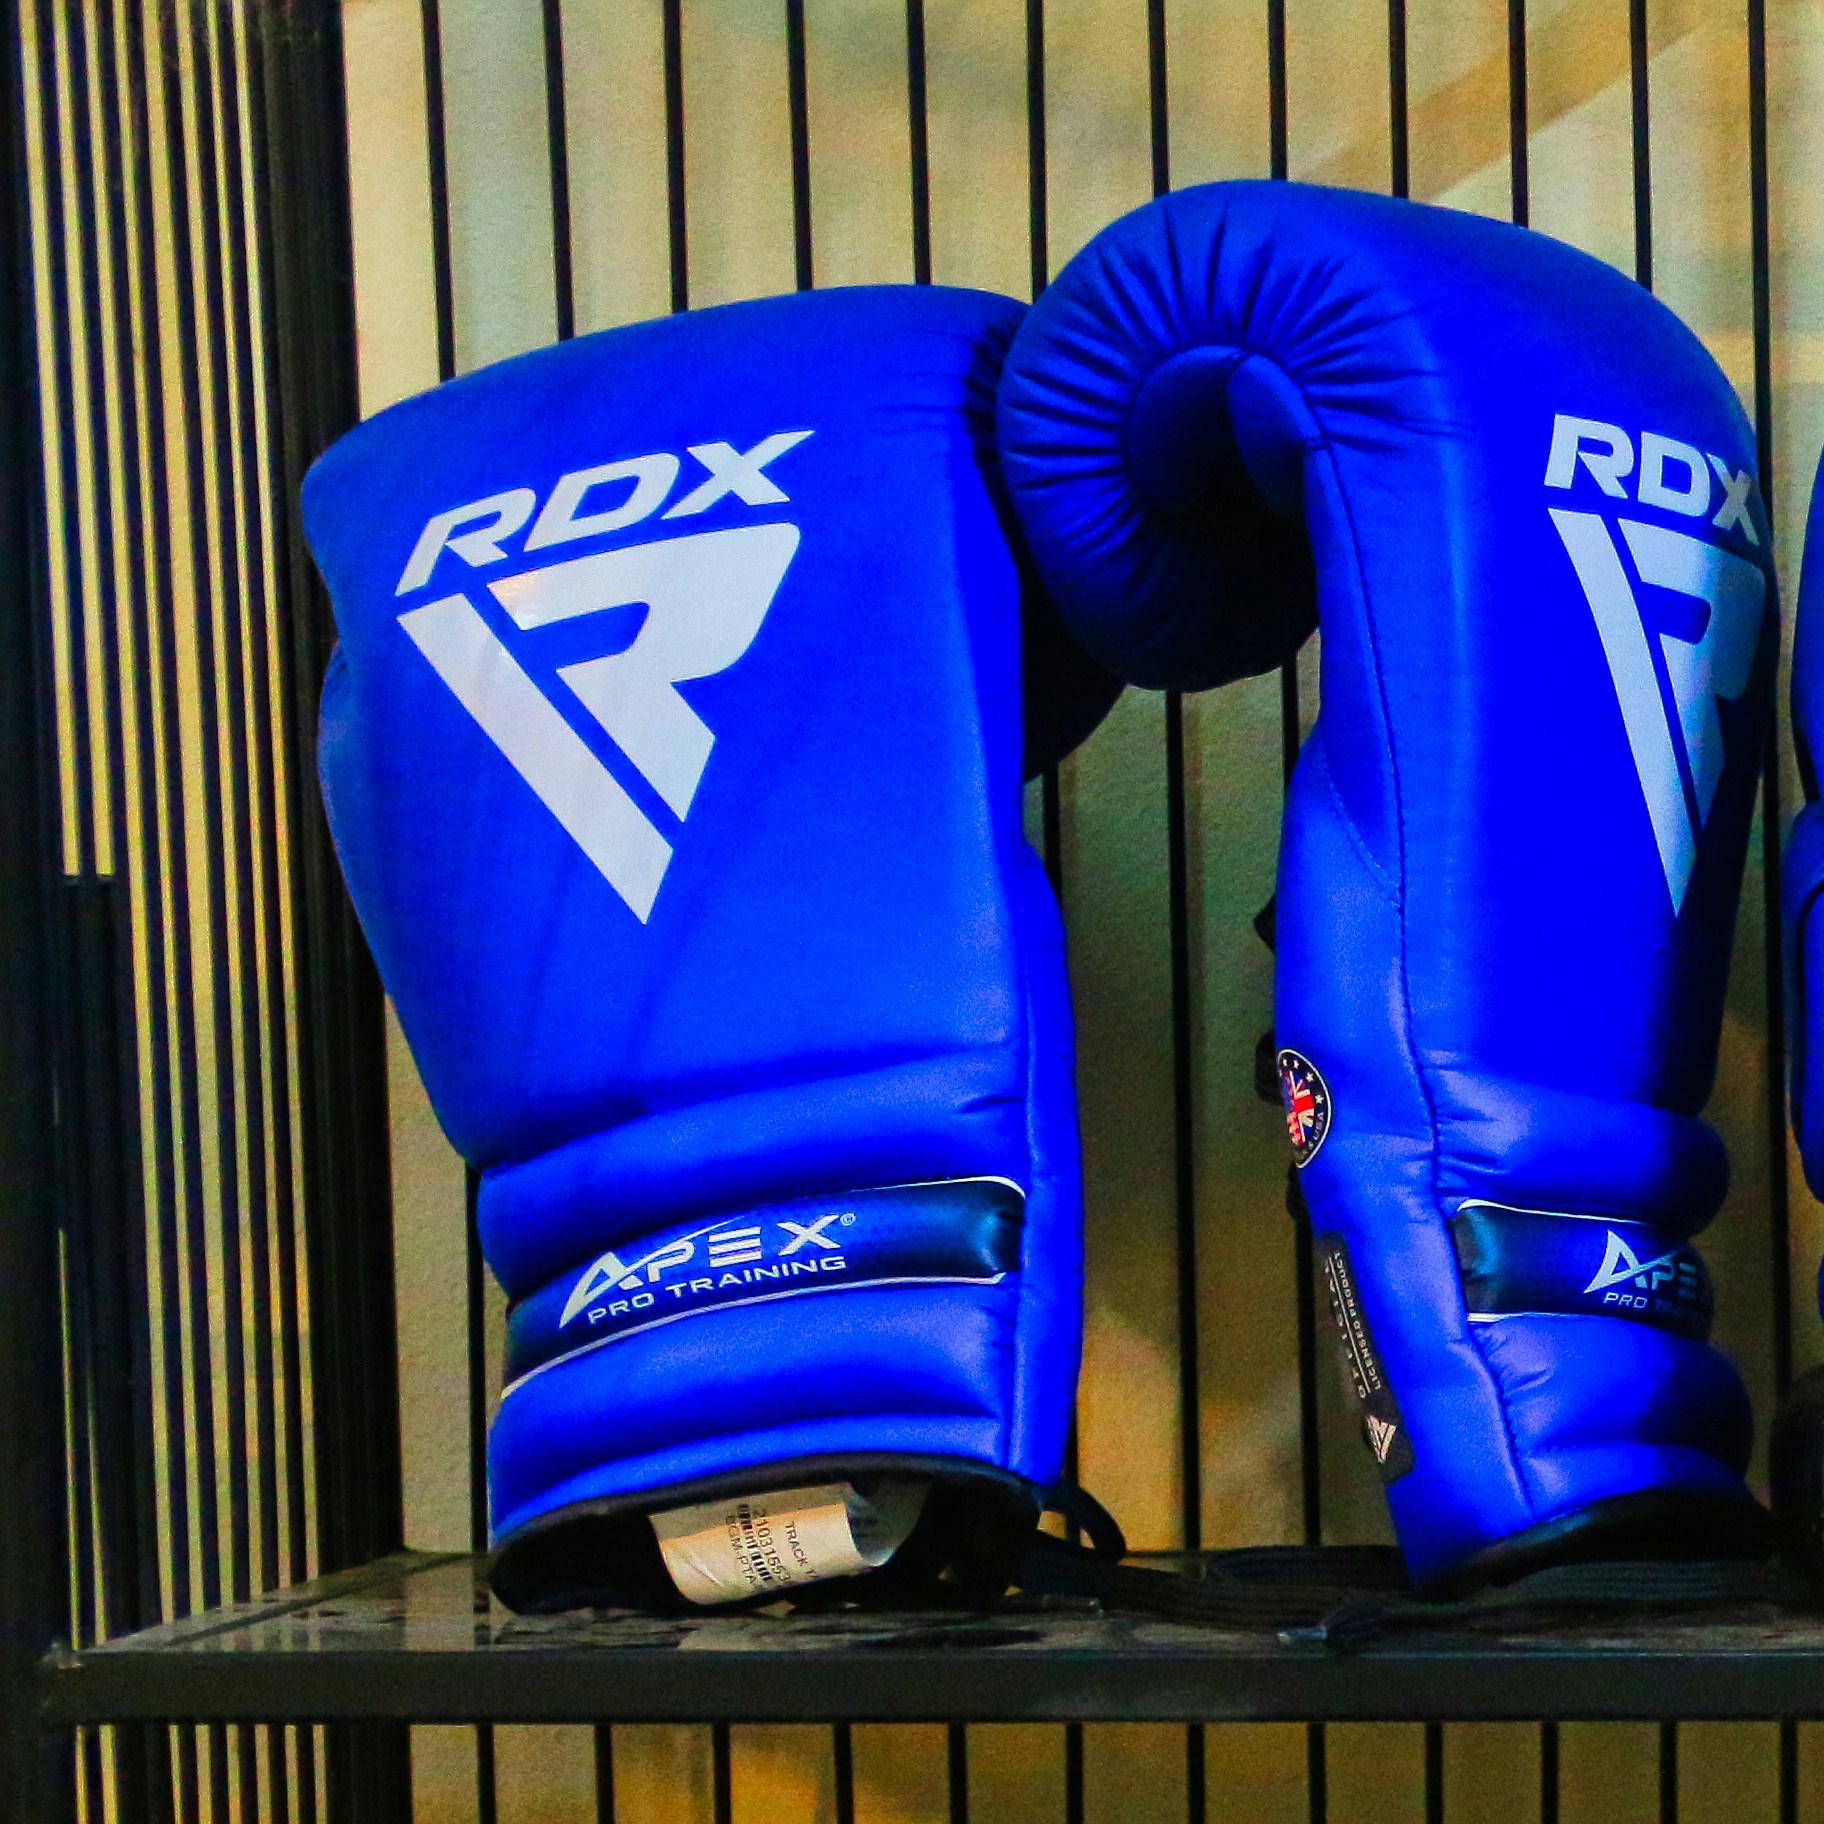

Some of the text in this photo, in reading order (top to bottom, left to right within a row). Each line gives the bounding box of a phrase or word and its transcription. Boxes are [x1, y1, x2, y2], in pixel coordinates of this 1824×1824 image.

[395, 429, 815, 597] RDX
[1544, 412, 1761, 547] RDX
[587, 1256, 848, 1326] PRO TRAINING
[1333, 1251, 1383, 1391] LICENSED PRODUCT
[1602, 1291, 1648, 1310] PRO
[784, 1520, 810, 1567] TRACK
